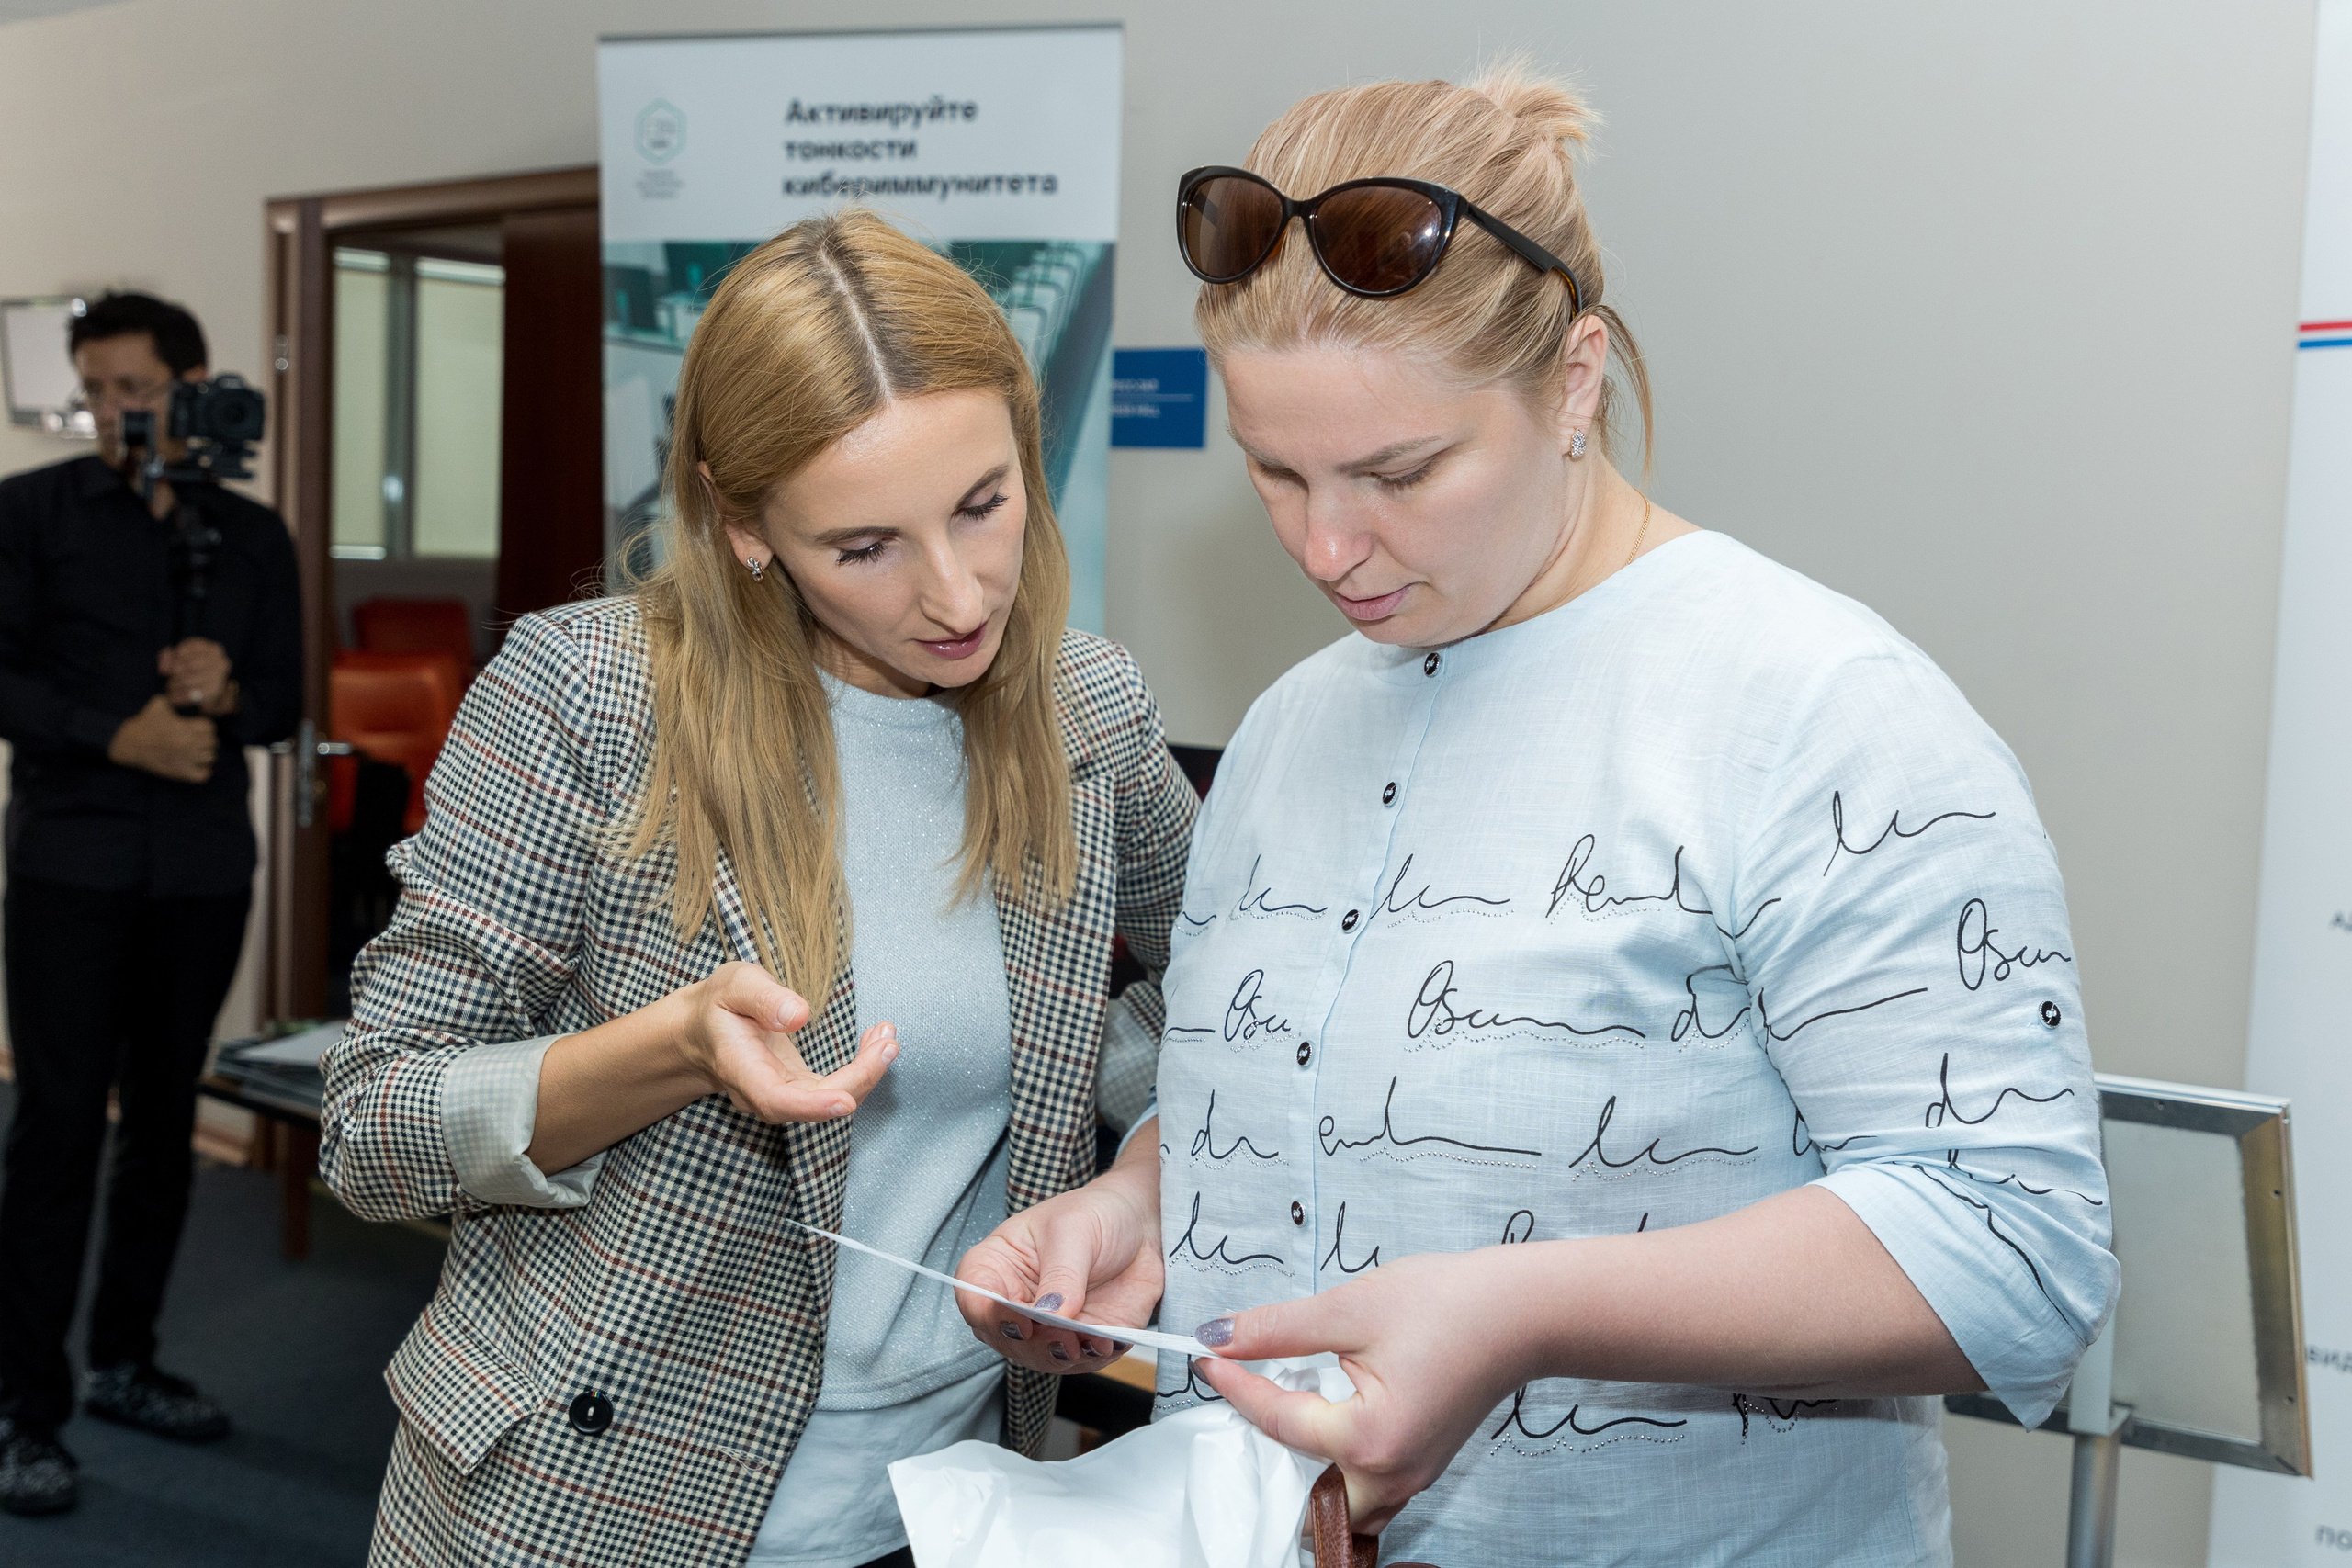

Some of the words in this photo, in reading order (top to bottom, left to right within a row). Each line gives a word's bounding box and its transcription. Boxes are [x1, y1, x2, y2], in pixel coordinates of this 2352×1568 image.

[786, 94, 978, 130] Активируйте
[785, 140, 918, 161] тонкости
[783, 169, 1058, 202] кибериммунитета
